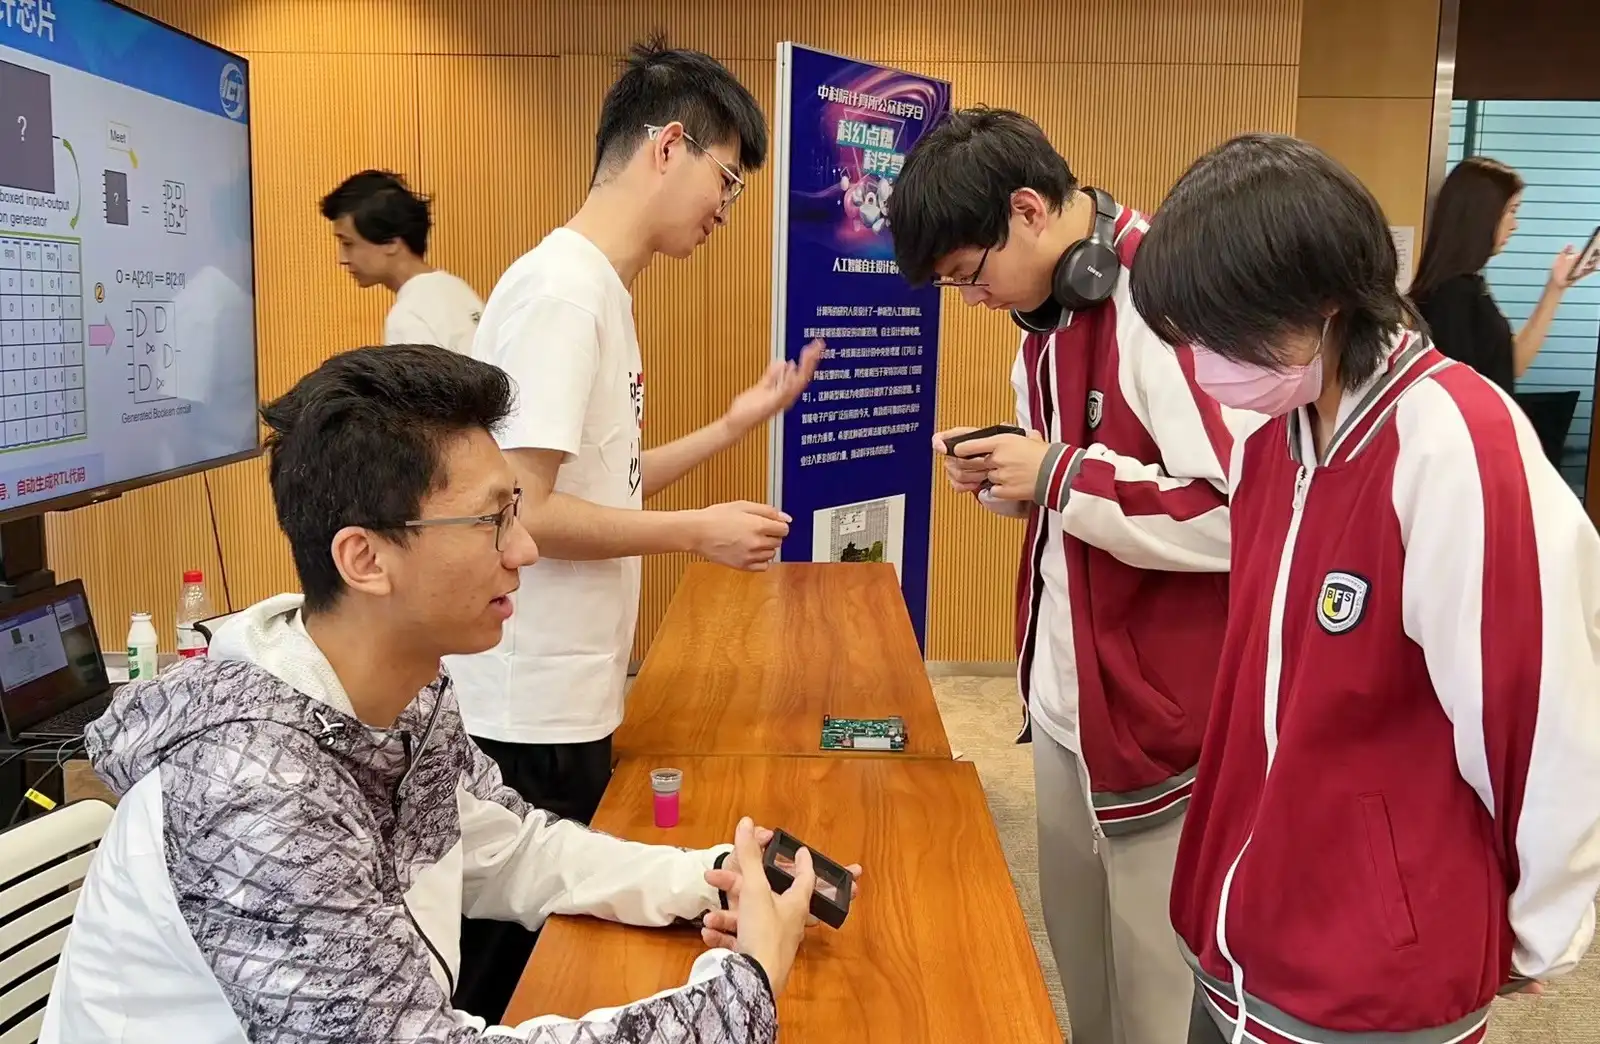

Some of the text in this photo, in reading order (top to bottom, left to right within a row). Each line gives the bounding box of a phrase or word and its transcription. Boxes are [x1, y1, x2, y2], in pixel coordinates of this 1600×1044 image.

[817, 84, 924, 121] 中科院计算所公众科学日
[110, 129, 127, 144] Meet
[26, 193, 70, 213] input-output
[10, 213, 47, 227] generator
[132, 270, 153, 288] A[2:0]
[121, 411, 152, 424] Generated
[153, 407, 176, 419] Boolean
[1326, 589, 1352, 603] BFS
